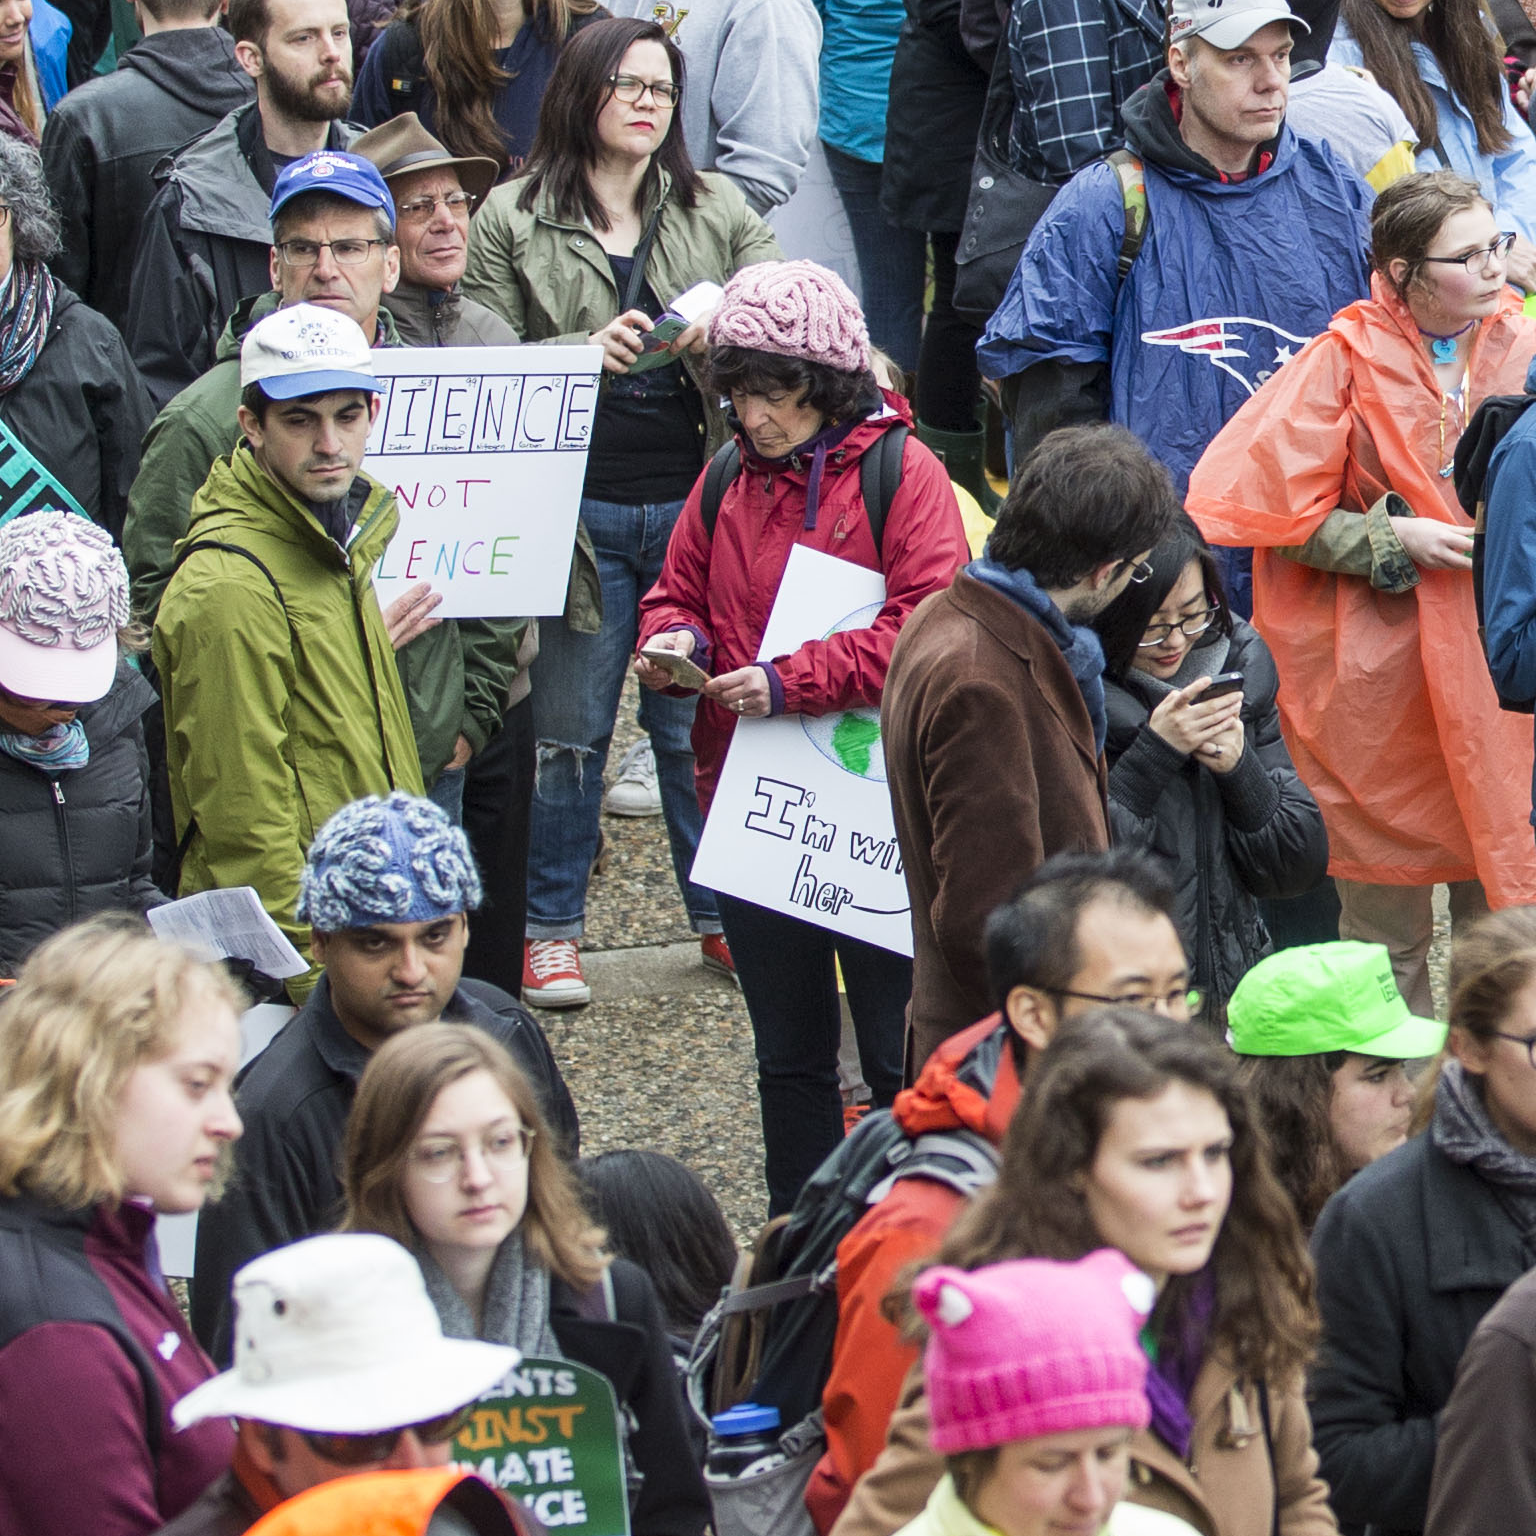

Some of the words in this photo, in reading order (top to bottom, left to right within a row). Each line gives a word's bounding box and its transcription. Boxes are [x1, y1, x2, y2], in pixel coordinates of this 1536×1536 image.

[395, 479, 492, 509] NOT
[745, 776, 837, 853] I'm
[789, 853, 854, 916] her
